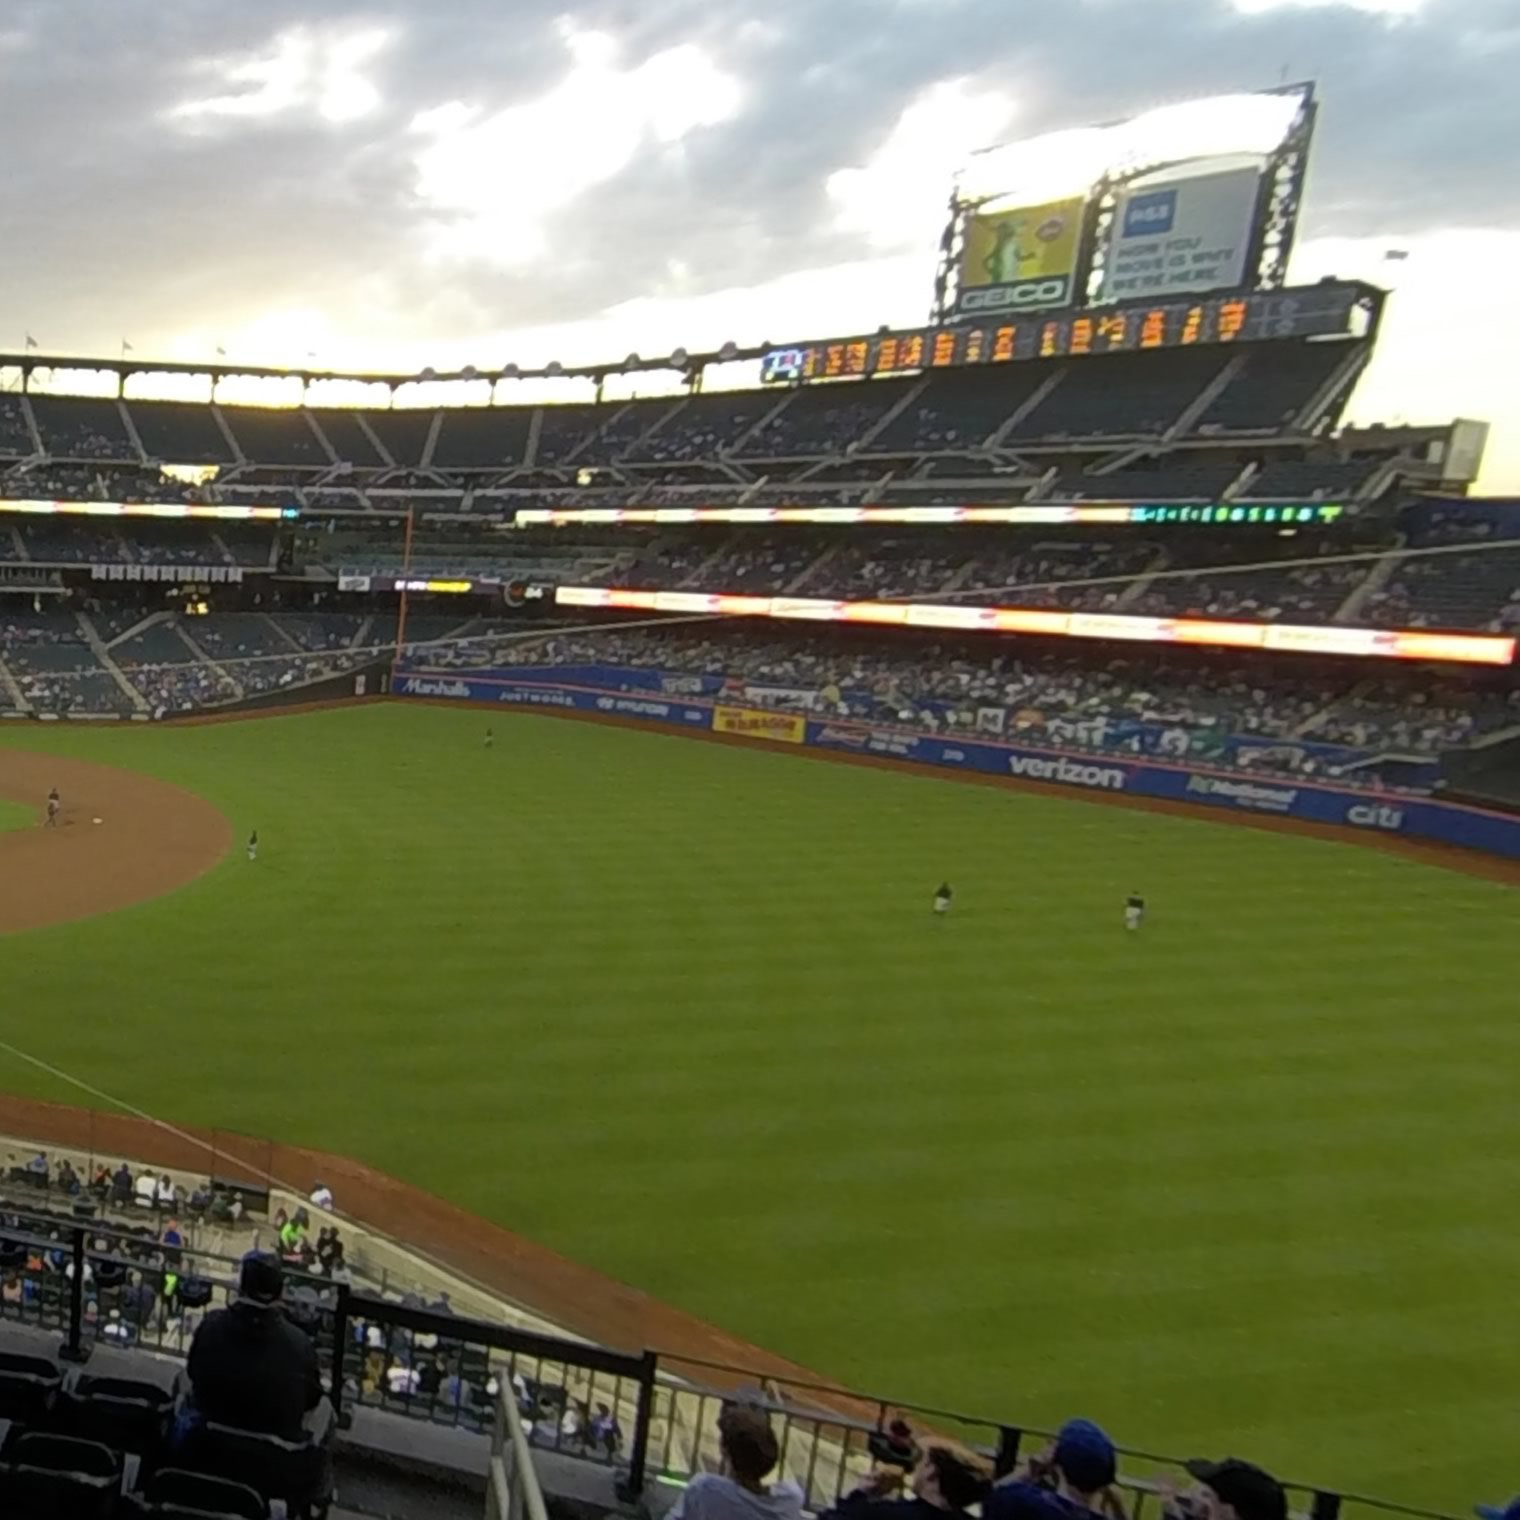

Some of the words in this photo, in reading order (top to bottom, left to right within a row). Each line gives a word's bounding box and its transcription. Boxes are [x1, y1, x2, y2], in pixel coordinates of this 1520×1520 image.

[1167, 236, 1203, 251] YOU
[1116, 258, 1164, 274] MOVE
[960, 280, 1065, 310] GEICO
[401, 677, 471, 698] Marshalls
[1009, 755, 1126, 790] verizon
[1346, 803, 1404, 829] citi
